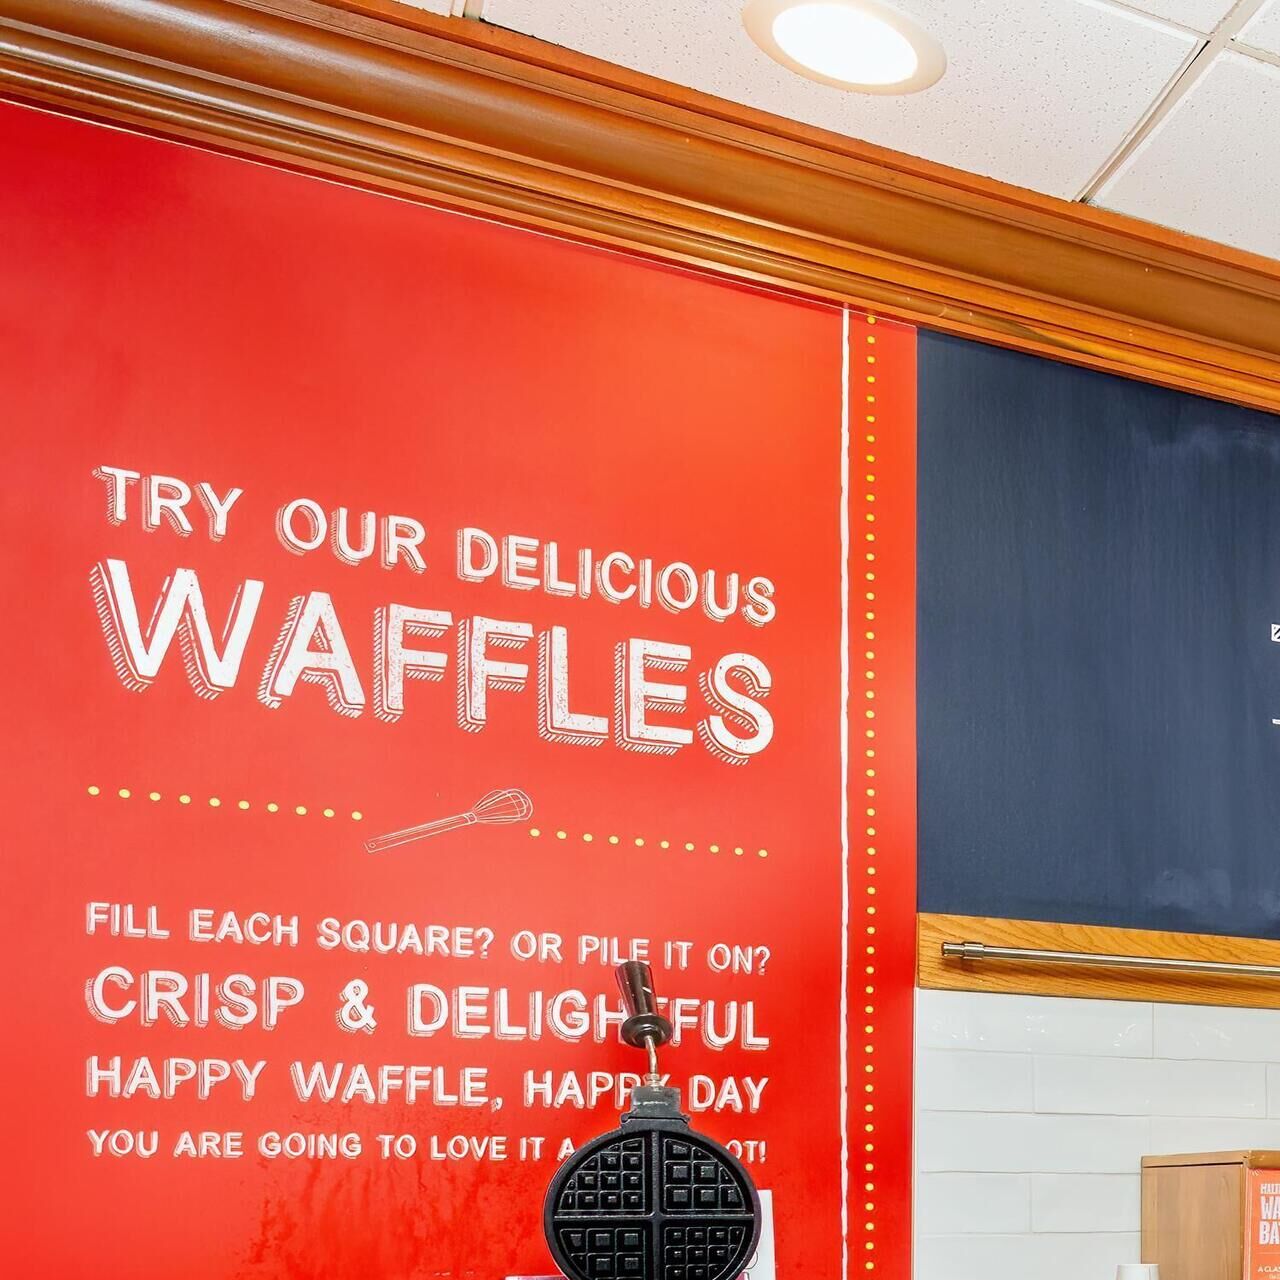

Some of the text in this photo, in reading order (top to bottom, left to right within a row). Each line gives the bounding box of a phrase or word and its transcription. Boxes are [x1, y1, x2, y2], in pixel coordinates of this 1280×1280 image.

[92, 465, 776, 627] TRY OUR DELICIOUS
[89, 558, 774, 766] WAFFLES
[86, 902, 771, 976] FILL EACH SQUARE? OR PILE IT ON?
[84, 966, 769, 1051] CRISP & DELIGHFUL
[86, 1055, 267, 1101] HAPPY
[290, 1061, 503, 1112] WAFFLE,
[688, 1074, 769, 1114] DAY
[87, 1130, 159, 1158] YOU
[173, 1131, 243, 1158] ARE
[257, 1131, 362, 1159] GOING
[376, 1133, 417, 1160] TO
[430, 1135, 508, 1161] LOVE
[520, 1136, 545, 1161] IT
